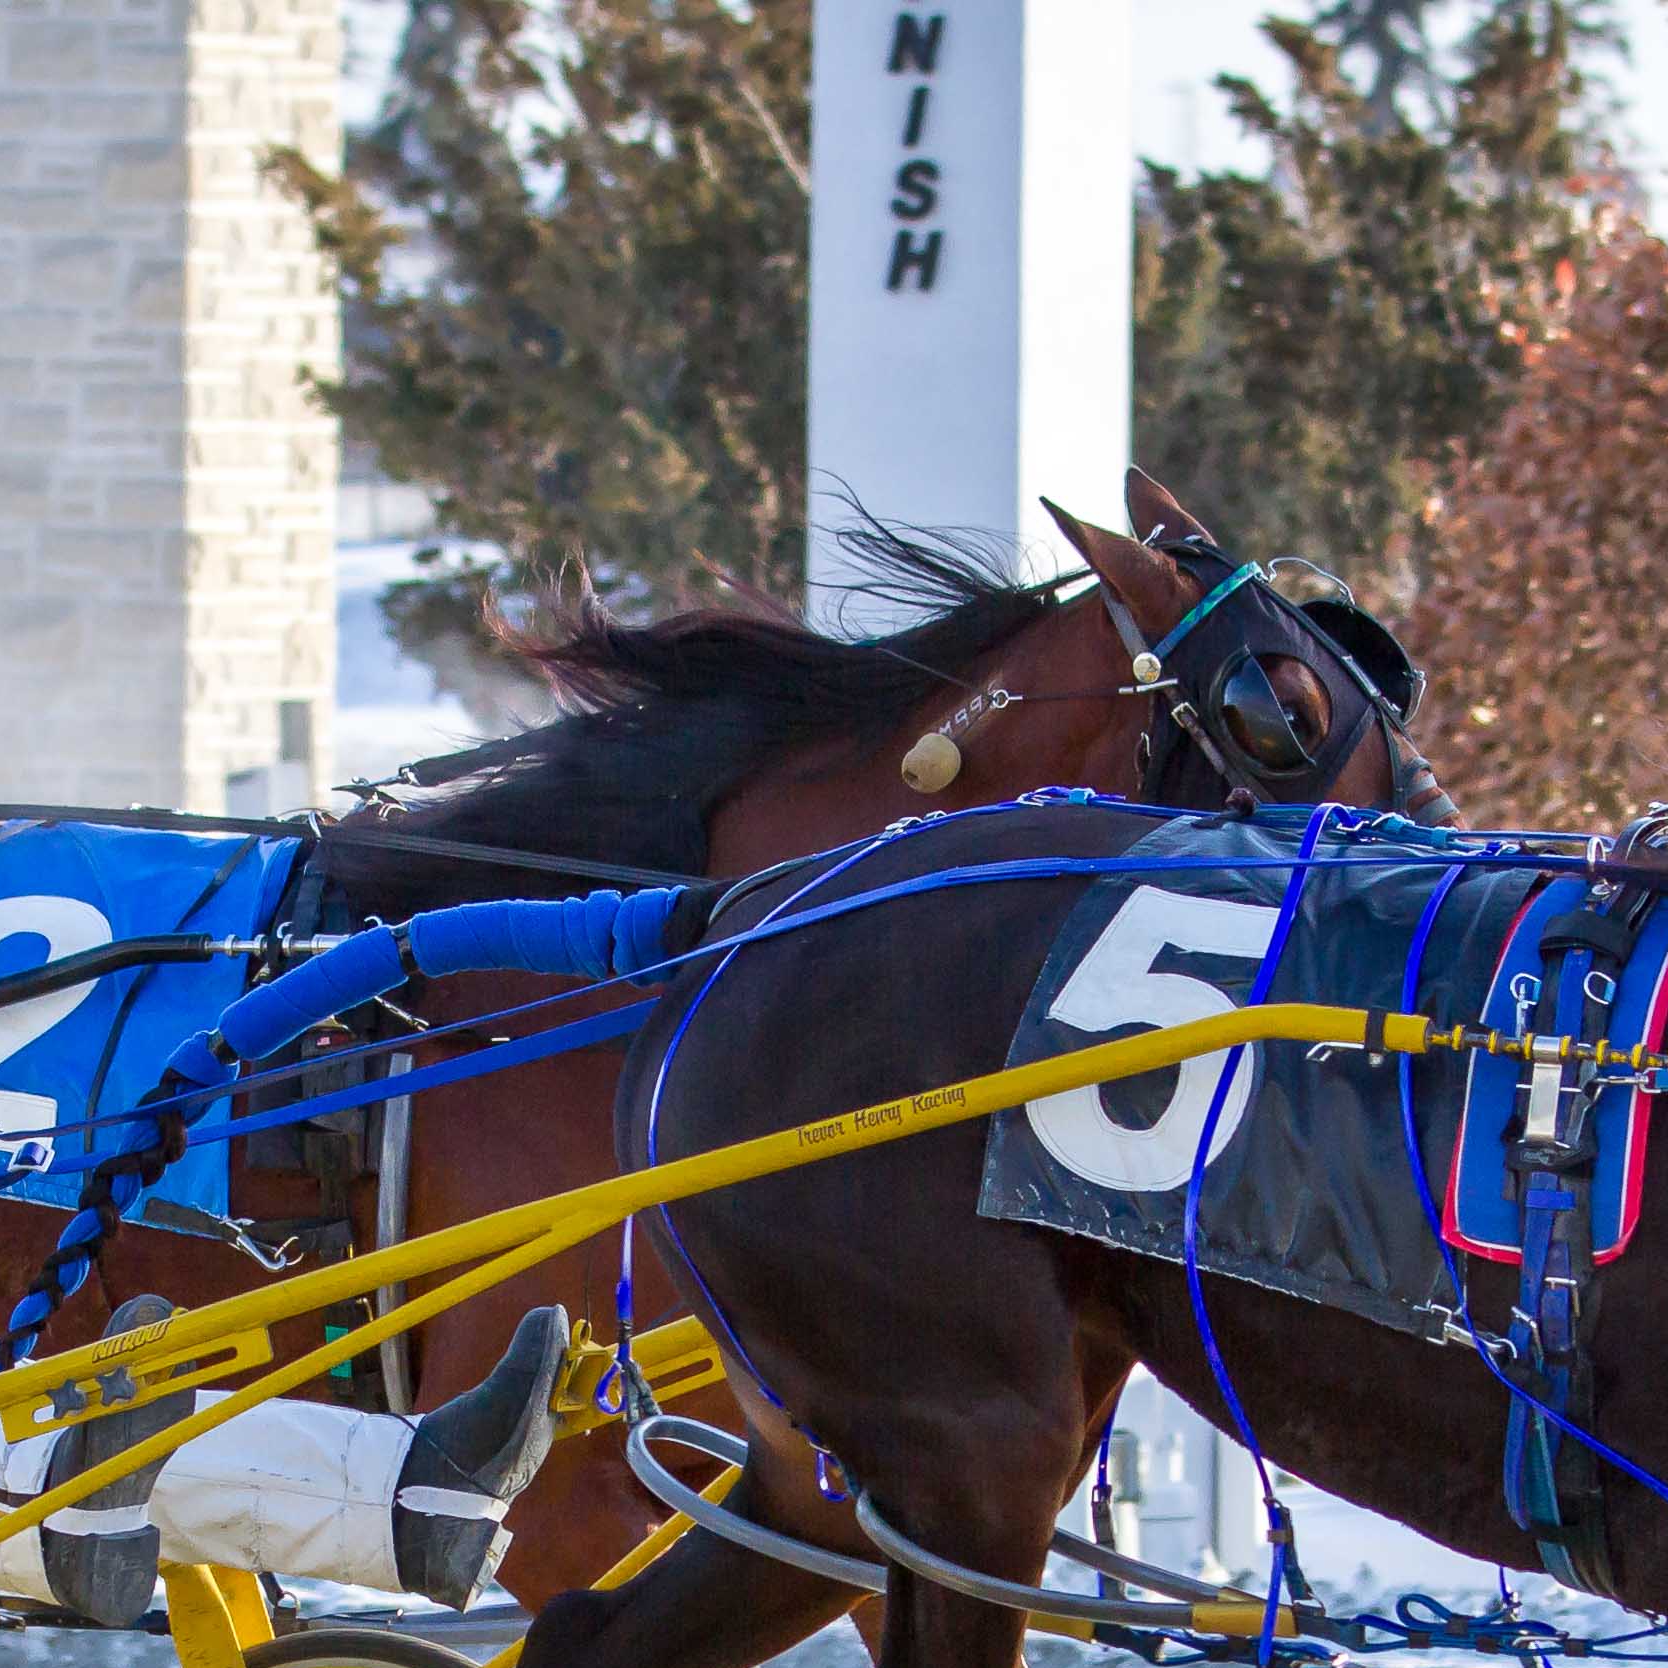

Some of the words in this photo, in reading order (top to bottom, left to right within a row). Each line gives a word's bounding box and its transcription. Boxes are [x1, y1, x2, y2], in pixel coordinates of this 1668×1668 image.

[796, 1121, 845, 1147] Trevor
[854, 1105, 902, 1133] Henry
[909, 1087, 967, 1114] Racing
[1024, 884, 1293, 1192] 5
